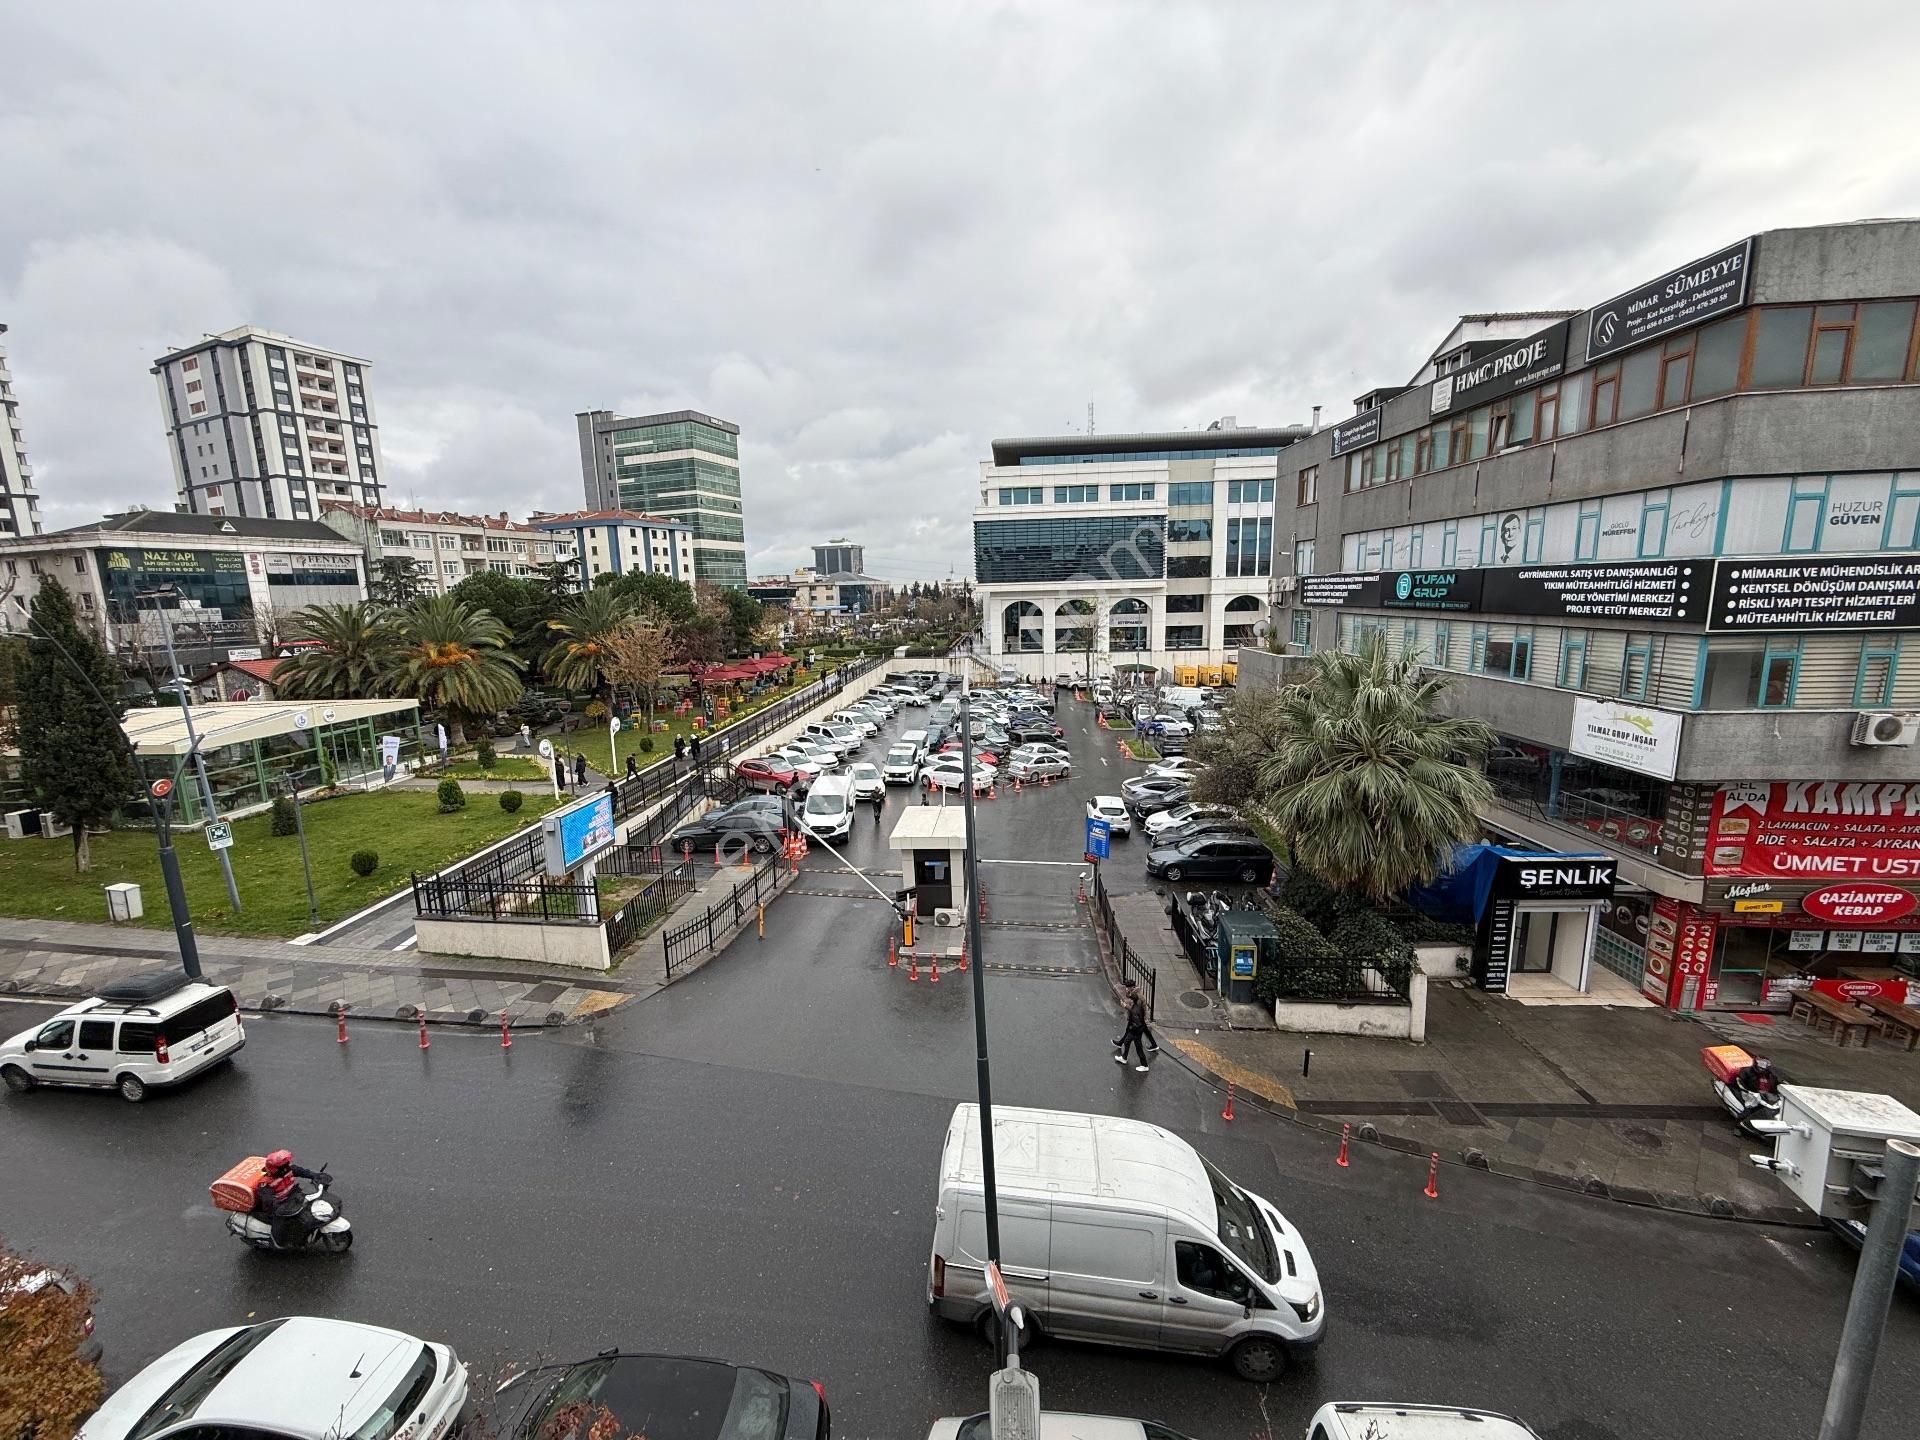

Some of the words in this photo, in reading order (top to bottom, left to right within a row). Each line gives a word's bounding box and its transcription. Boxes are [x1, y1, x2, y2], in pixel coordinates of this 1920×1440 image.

[1626, 317, 1643, 329] Proje
[1647, 310, 1658, 320] Kat
[1693, 279, 1736, 302] Dekorasyon
[1627, 294, 1659, 316] MİMAR
[1456, 362, 1494, 393] HMC
[1493, 339, 1547, 378] PROJE
[1831, 501, 1884, 513] HUZUR
[1829, 514, 1881, 526] GÜVEN
[144, 551, 167, 561] NAZ
[173, 552, 195, 561] YAPI
[1519, 569, 1570, 579] GAYRİMENKUL
[1570, 568, 1593, 580] SATIŞ
[1593, 568, 1605, 578] VE
[1607, 565, 1678, 578] DANIŞMANLIĞI
[1741, 567, 1801, 580] MİMARLIK
[1802, 568, 1818, 577] VE
[1820, 563, 1903, 578] MÜHENDİSLİK
[1414, 573, 1456, 585] TUFAN
[1544, 581, 1565, 590] YIKIM
[1565, 579, 1633, 590] MÜTEAHHİTLİĞİ
[1634, 578, 1676, 590] HİZMETİ
[1413, 588, 1448, 598] GRUP
[1741, 583, 1792, 594] KENTSEL
[1793, 580, 1856, 595] DÖNÜŞÜM
[1858, 579, 1914, 593] DANIŞMA
[1561, 593, 1586, 602] PROJE
[1586, 591, 1630, 602] YÖNETİMİ
[1631, 592, 1675, 603] MERKEZİ
[1738, 596, 1774, 609] RİSKLİ
[1776, 598, 1801, 608] YAPI
[1804, 595, 1843, 607] TESPİT
[1845, 593, 1917, 606] HİZMETLERİ
[1566, 605, 1591, 614] PROJE
[1592, 606, 1604, 614] VE
[1604, 604, 1628, 615] ETÜT
[1629, 606, 1673, 616] MERKEZİ
[1736, 610, 1824, 624] MÜTEAHHİTLİK
[1825, 608, 1897, 622] HİZMETLERİ
[1612, 729, 1631, 741] GRUP
[1727, 791, 1767, 802] AL'DA
[1757, 820, 1765, 829] 2
[1767, 821, 1831, 831] LAHMACUN
[1843, 823, 1886, 833] SALATA
[1755, 832, 1787, 846] PİDE
[1803, 835, 1856, 848] SALATA
[1773, 852, 1867, 873] ÜMMET
[1520, 865, 1613, 889] ŞENLİK
[1724, 882, 1772, 899] Meşhur
[1819, 890, 1904, 904] GAZİANTEP
[1833, 906, 1884, 916] KEBAP
